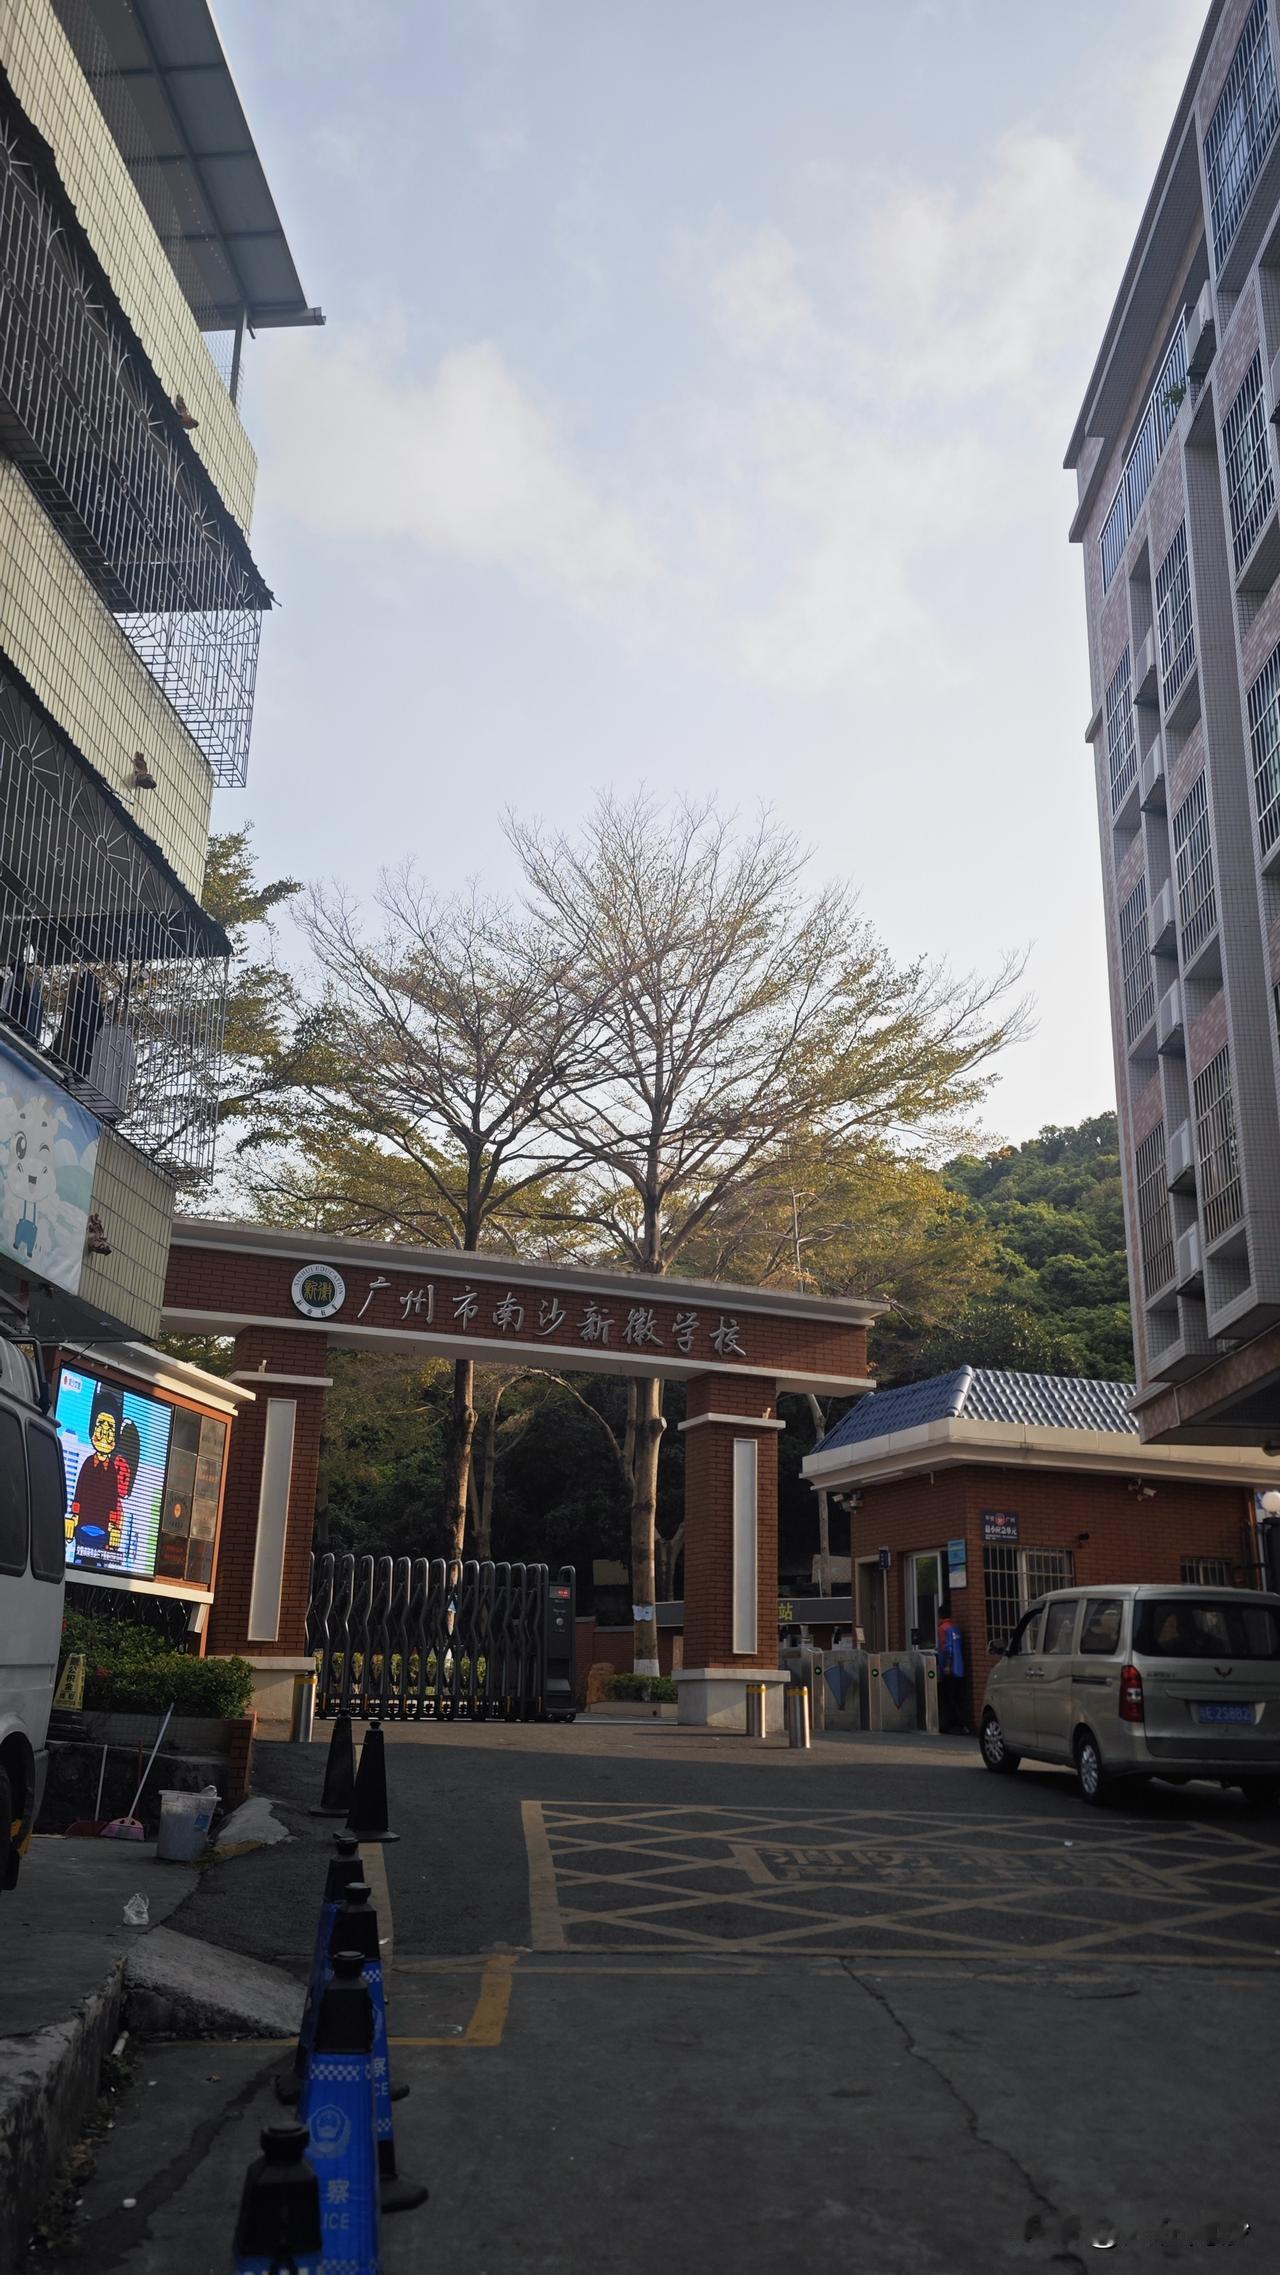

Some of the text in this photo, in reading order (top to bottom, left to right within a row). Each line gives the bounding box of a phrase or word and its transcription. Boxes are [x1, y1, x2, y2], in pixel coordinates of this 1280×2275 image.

[357, 1276, 746, 1357] 广州市南沙新徽学校
[324, 2178, 350, 2205] 察
[322, 2212, 352, 2231] ICE
